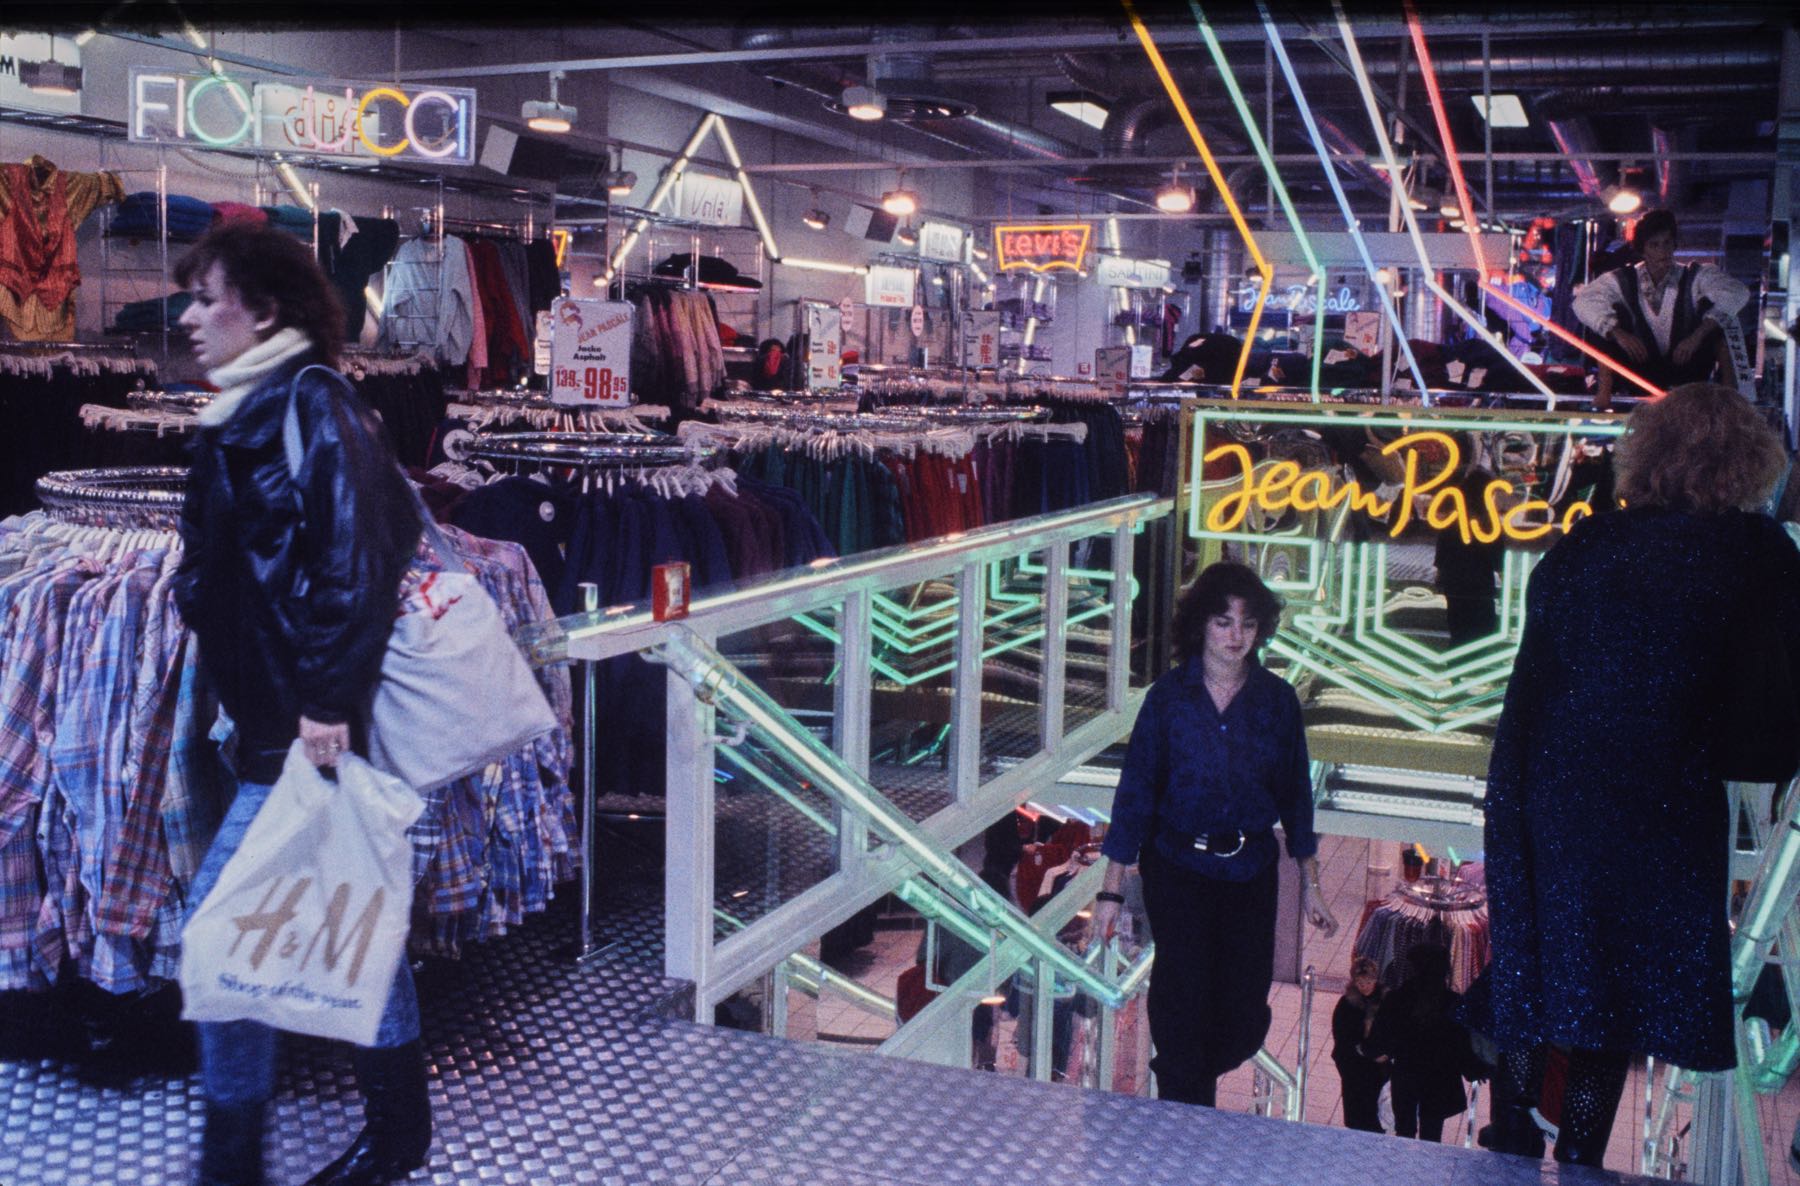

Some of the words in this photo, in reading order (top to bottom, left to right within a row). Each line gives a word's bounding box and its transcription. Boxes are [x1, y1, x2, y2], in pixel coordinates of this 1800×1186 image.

[573, 353, 606, 362] Asphalt
[1203, 443, 1393, 533] Jean
[228, 875, 386, 988] H&M
